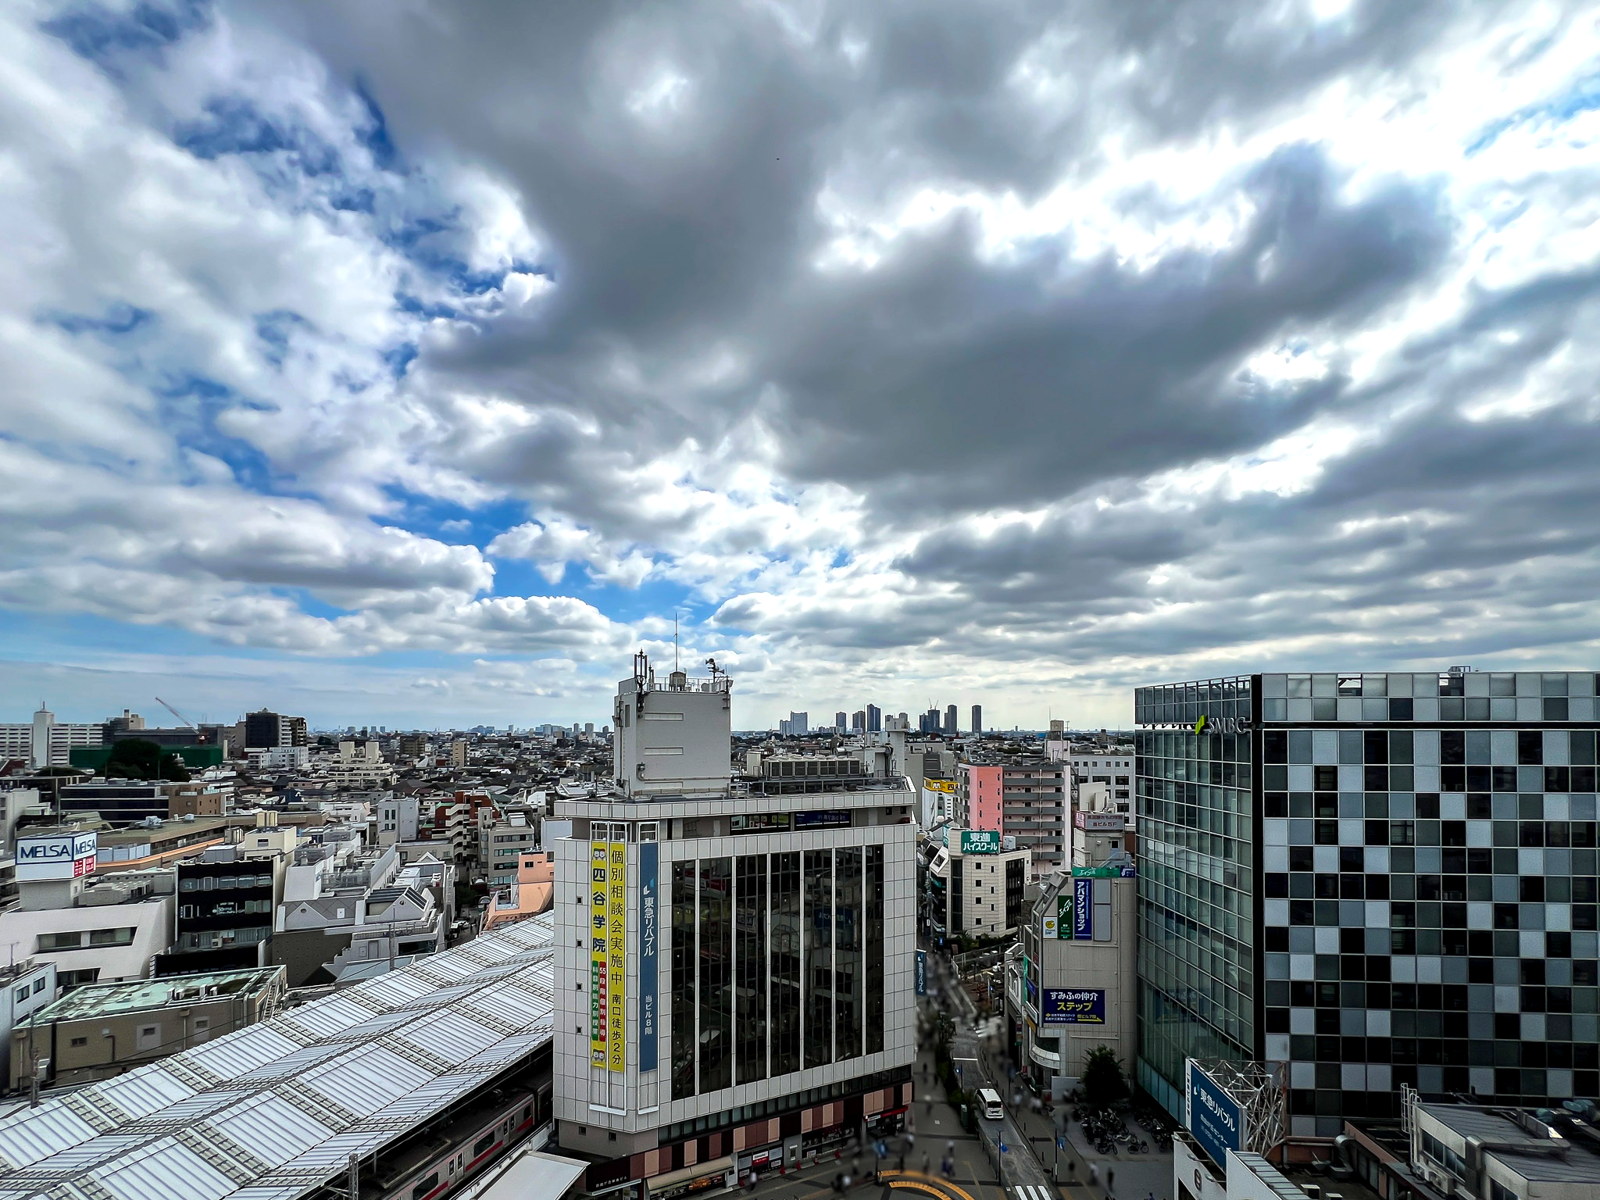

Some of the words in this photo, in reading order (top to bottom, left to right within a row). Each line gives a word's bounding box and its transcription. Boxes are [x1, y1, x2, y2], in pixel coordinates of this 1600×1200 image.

[1209, 717, 1246, 734] SMBC
[970, 833, 990, 842] 東進
[20, 844, 71, 859] MELSA
[76, 839, 96, 855] MELSA
[963, 842, 997, 851] ハイスクール
[592, 868, 606, 953] 四谷学院
[1077, 881, 1086, 931] アパマンショップ
[611, 850, 624, 985] 個別相談会実施中
[643, 897, 655, 957] 東急リバブル
[1050, 991, 1099, 1001] すみふの仲介
[1057, 1002, 1093, 1011] ステップ
[612, 993, 622, 1065] 南口徒歩2分
[1200, 1088, 1236, 1132] 東急リバブル
